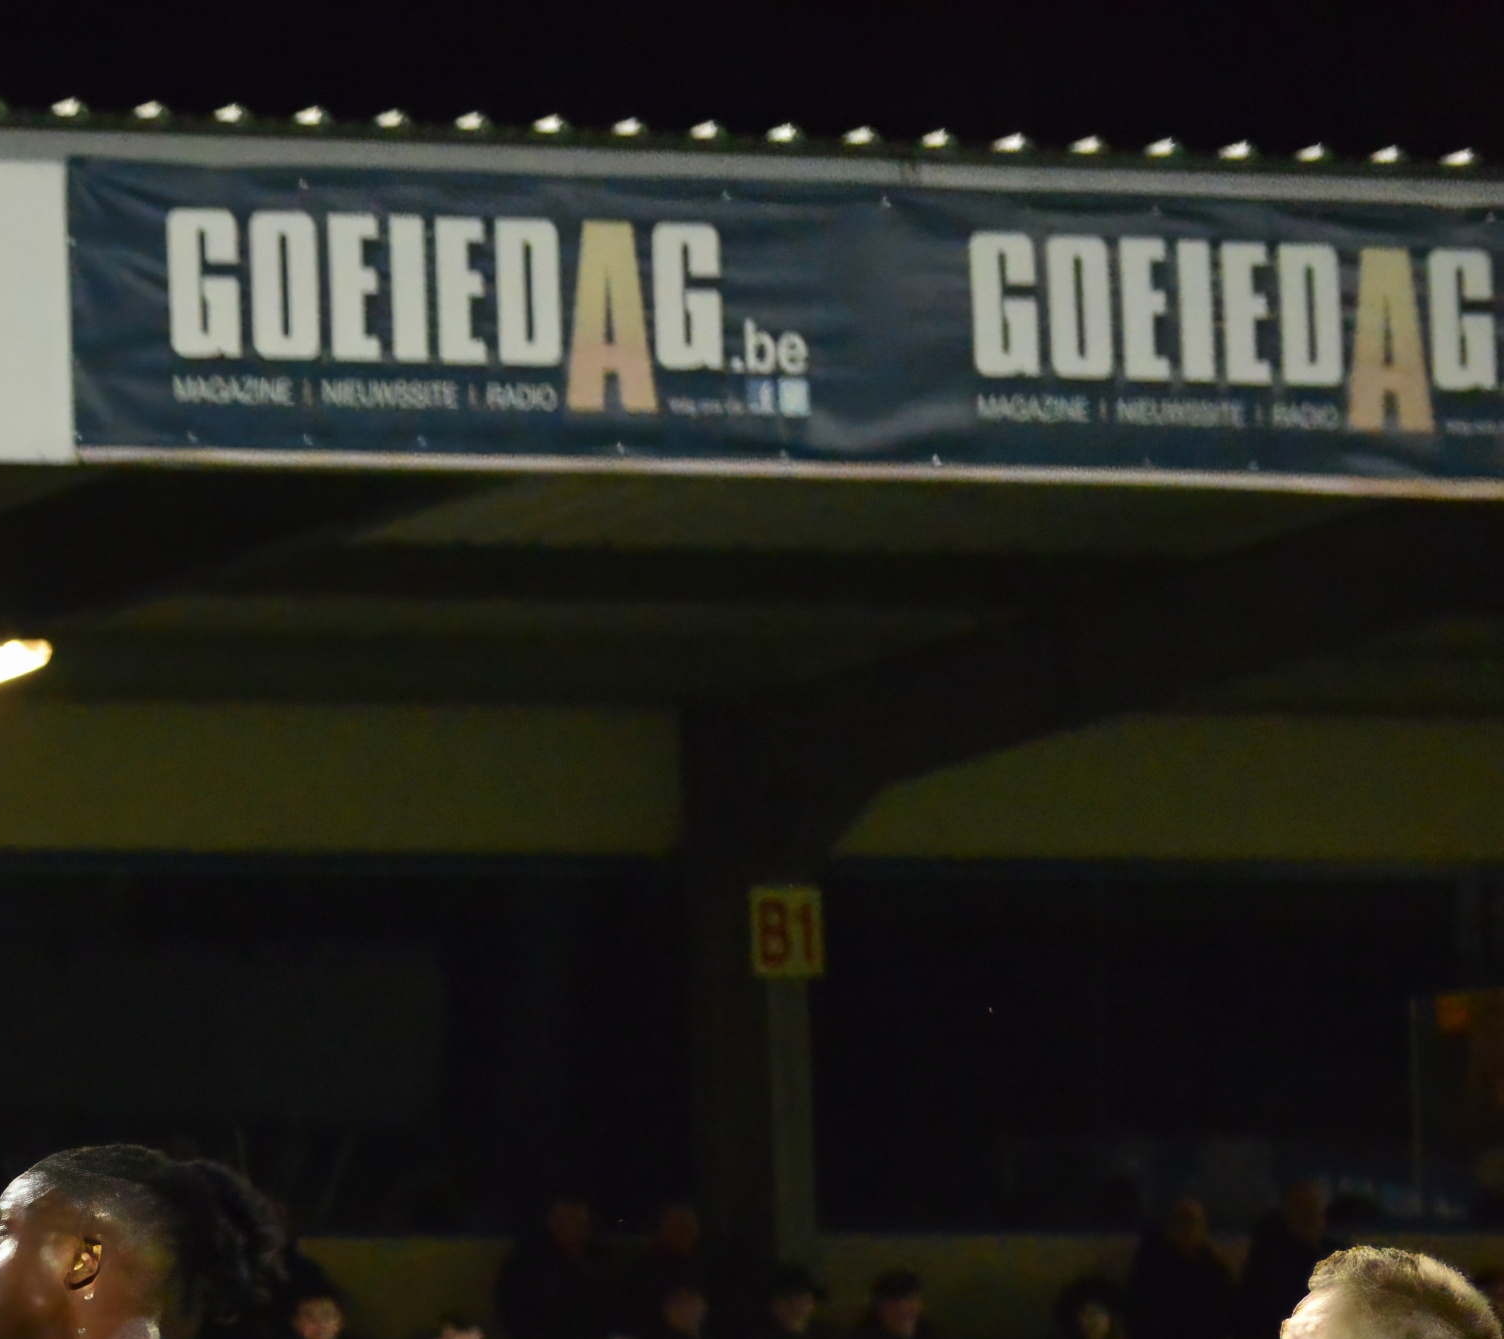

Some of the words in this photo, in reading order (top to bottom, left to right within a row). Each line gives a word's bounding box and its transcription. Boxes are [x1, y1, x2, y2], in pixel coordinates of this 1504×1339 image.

[173, 373, 294, 406] MAGAZINE
[485, 382, 560, 413] RADIO
[978, 393, 1090, 425] MAGAZINE
[1272, 402, 1357, 432] RADIO
[756, 897, 816, 970] B1
